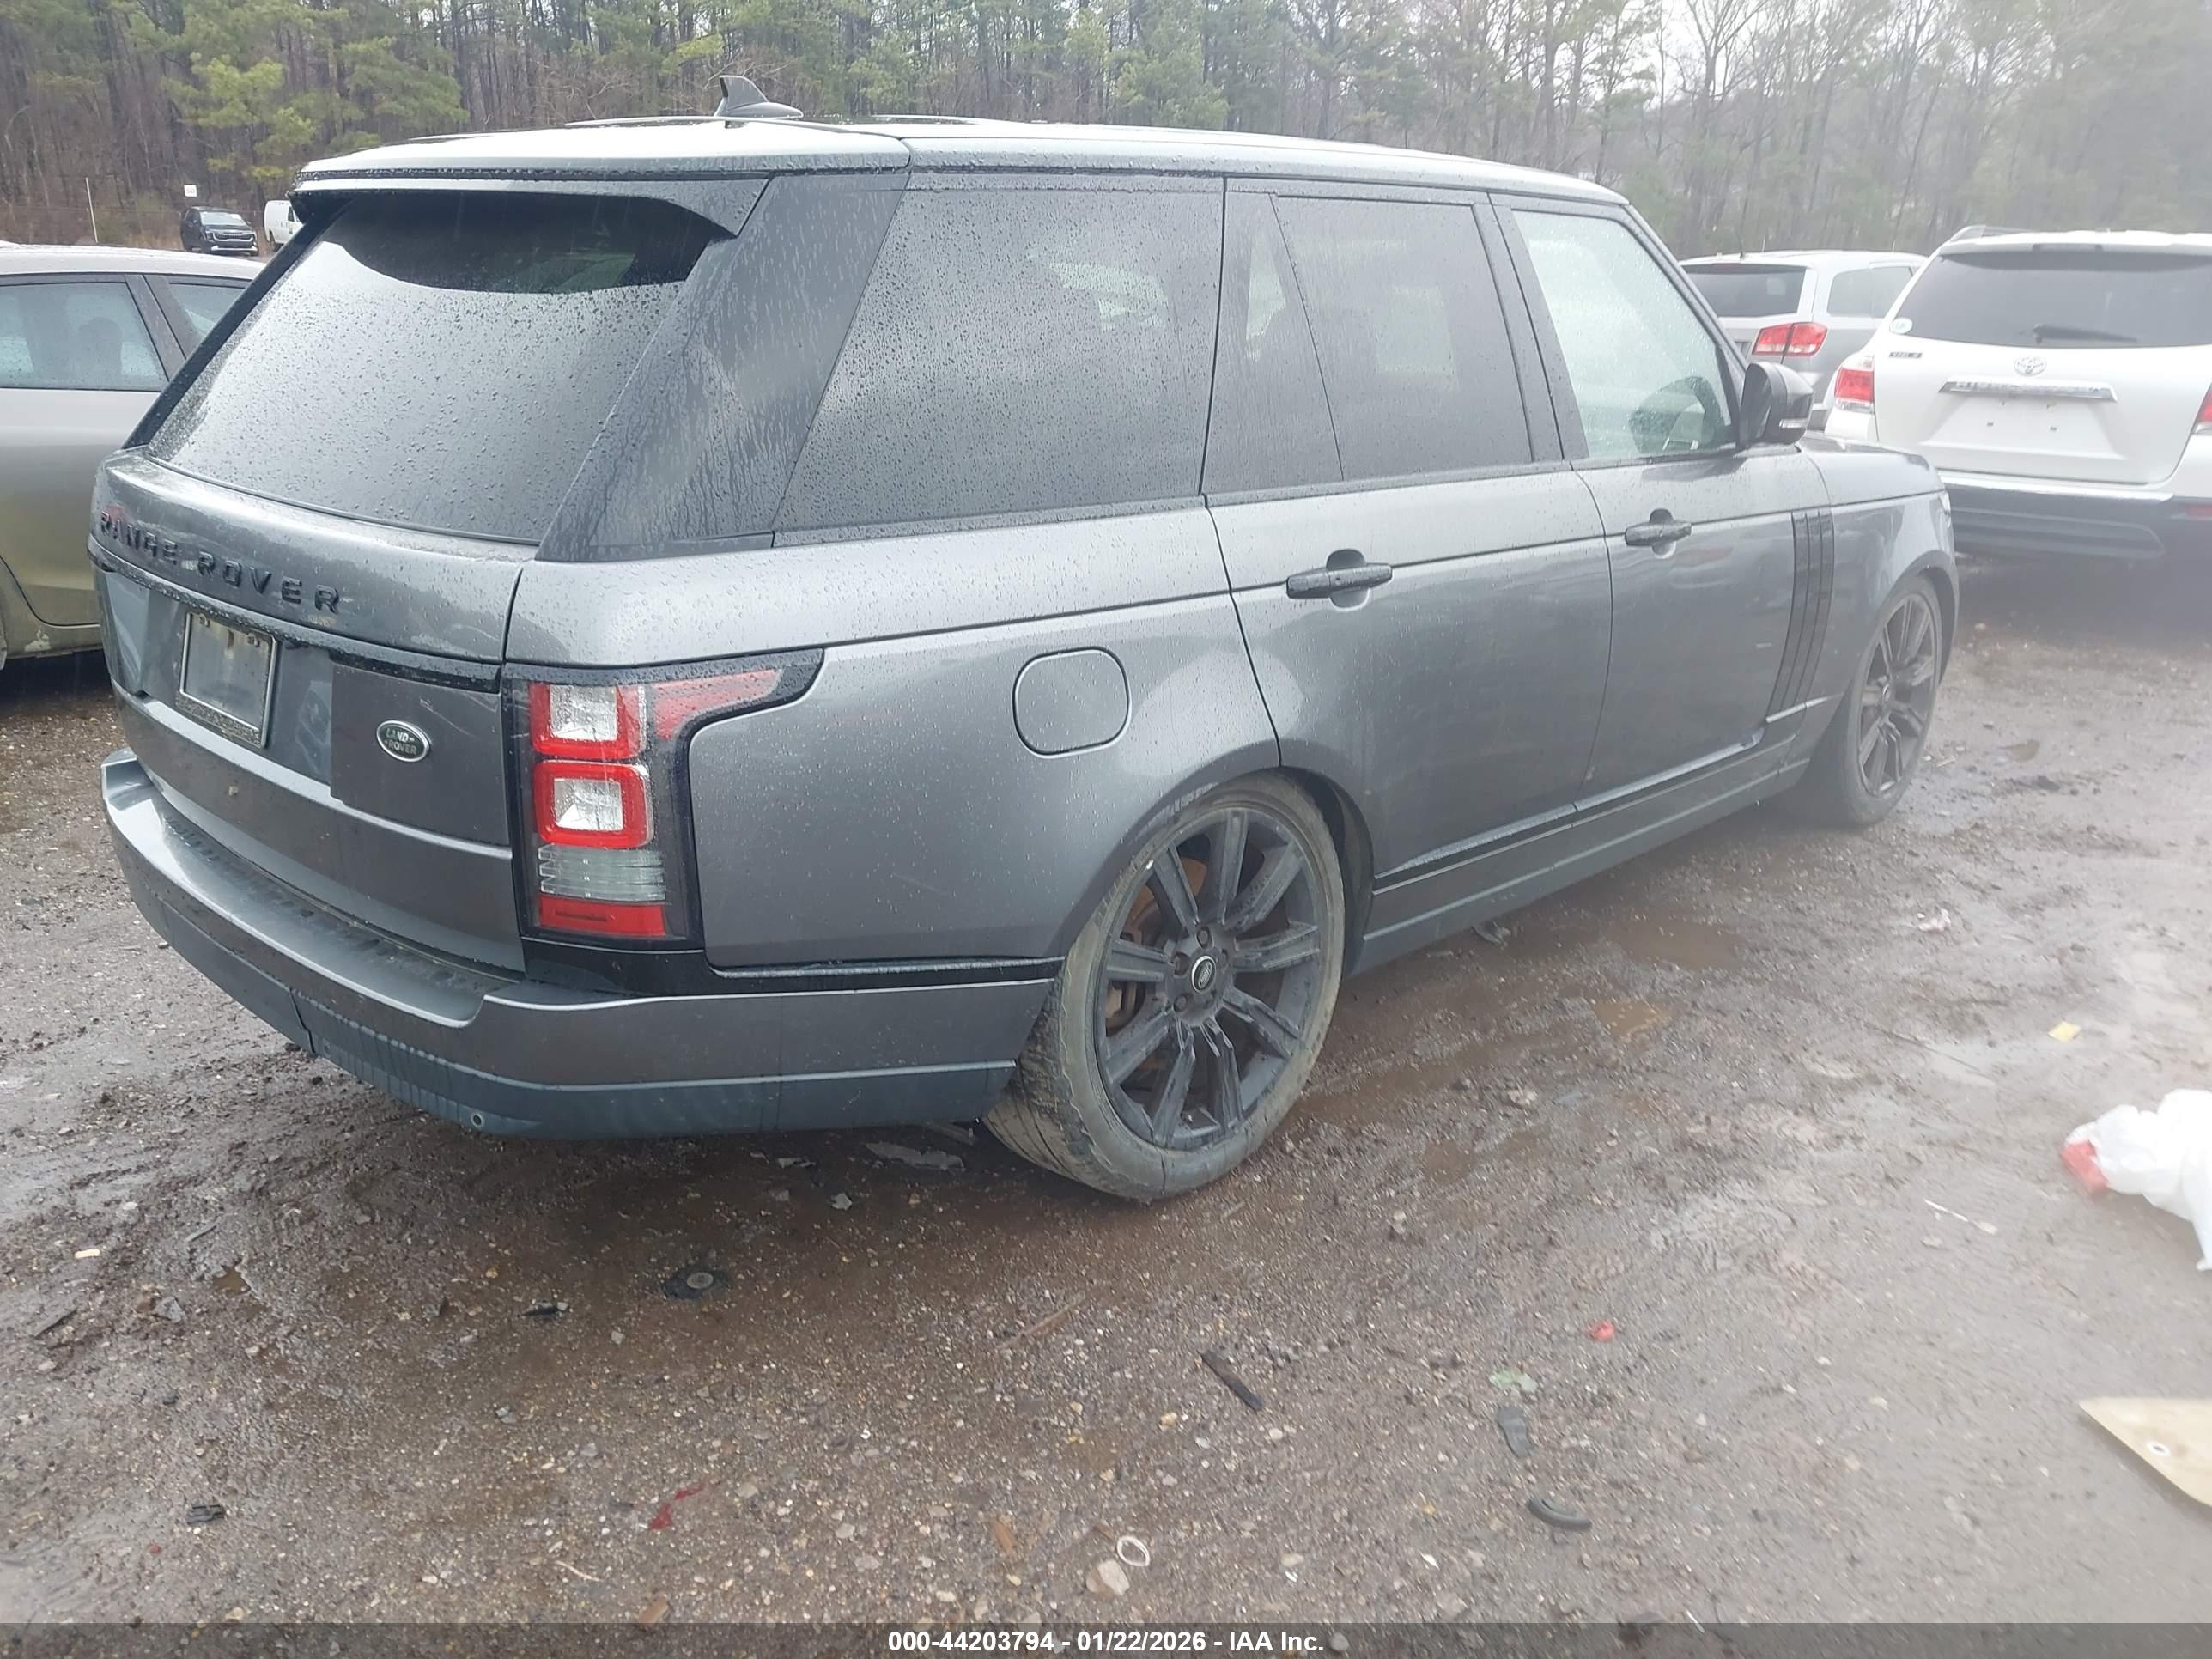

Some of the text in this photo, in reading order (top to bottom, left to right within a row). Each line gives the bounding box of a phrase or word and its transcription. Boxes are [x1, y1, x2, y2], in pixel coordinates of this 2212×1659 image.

[100, 510, 340, 614] RANGE ROVER
[386, 727, 409, 743] LAND
[388, 739, 417, 755] ROVER
